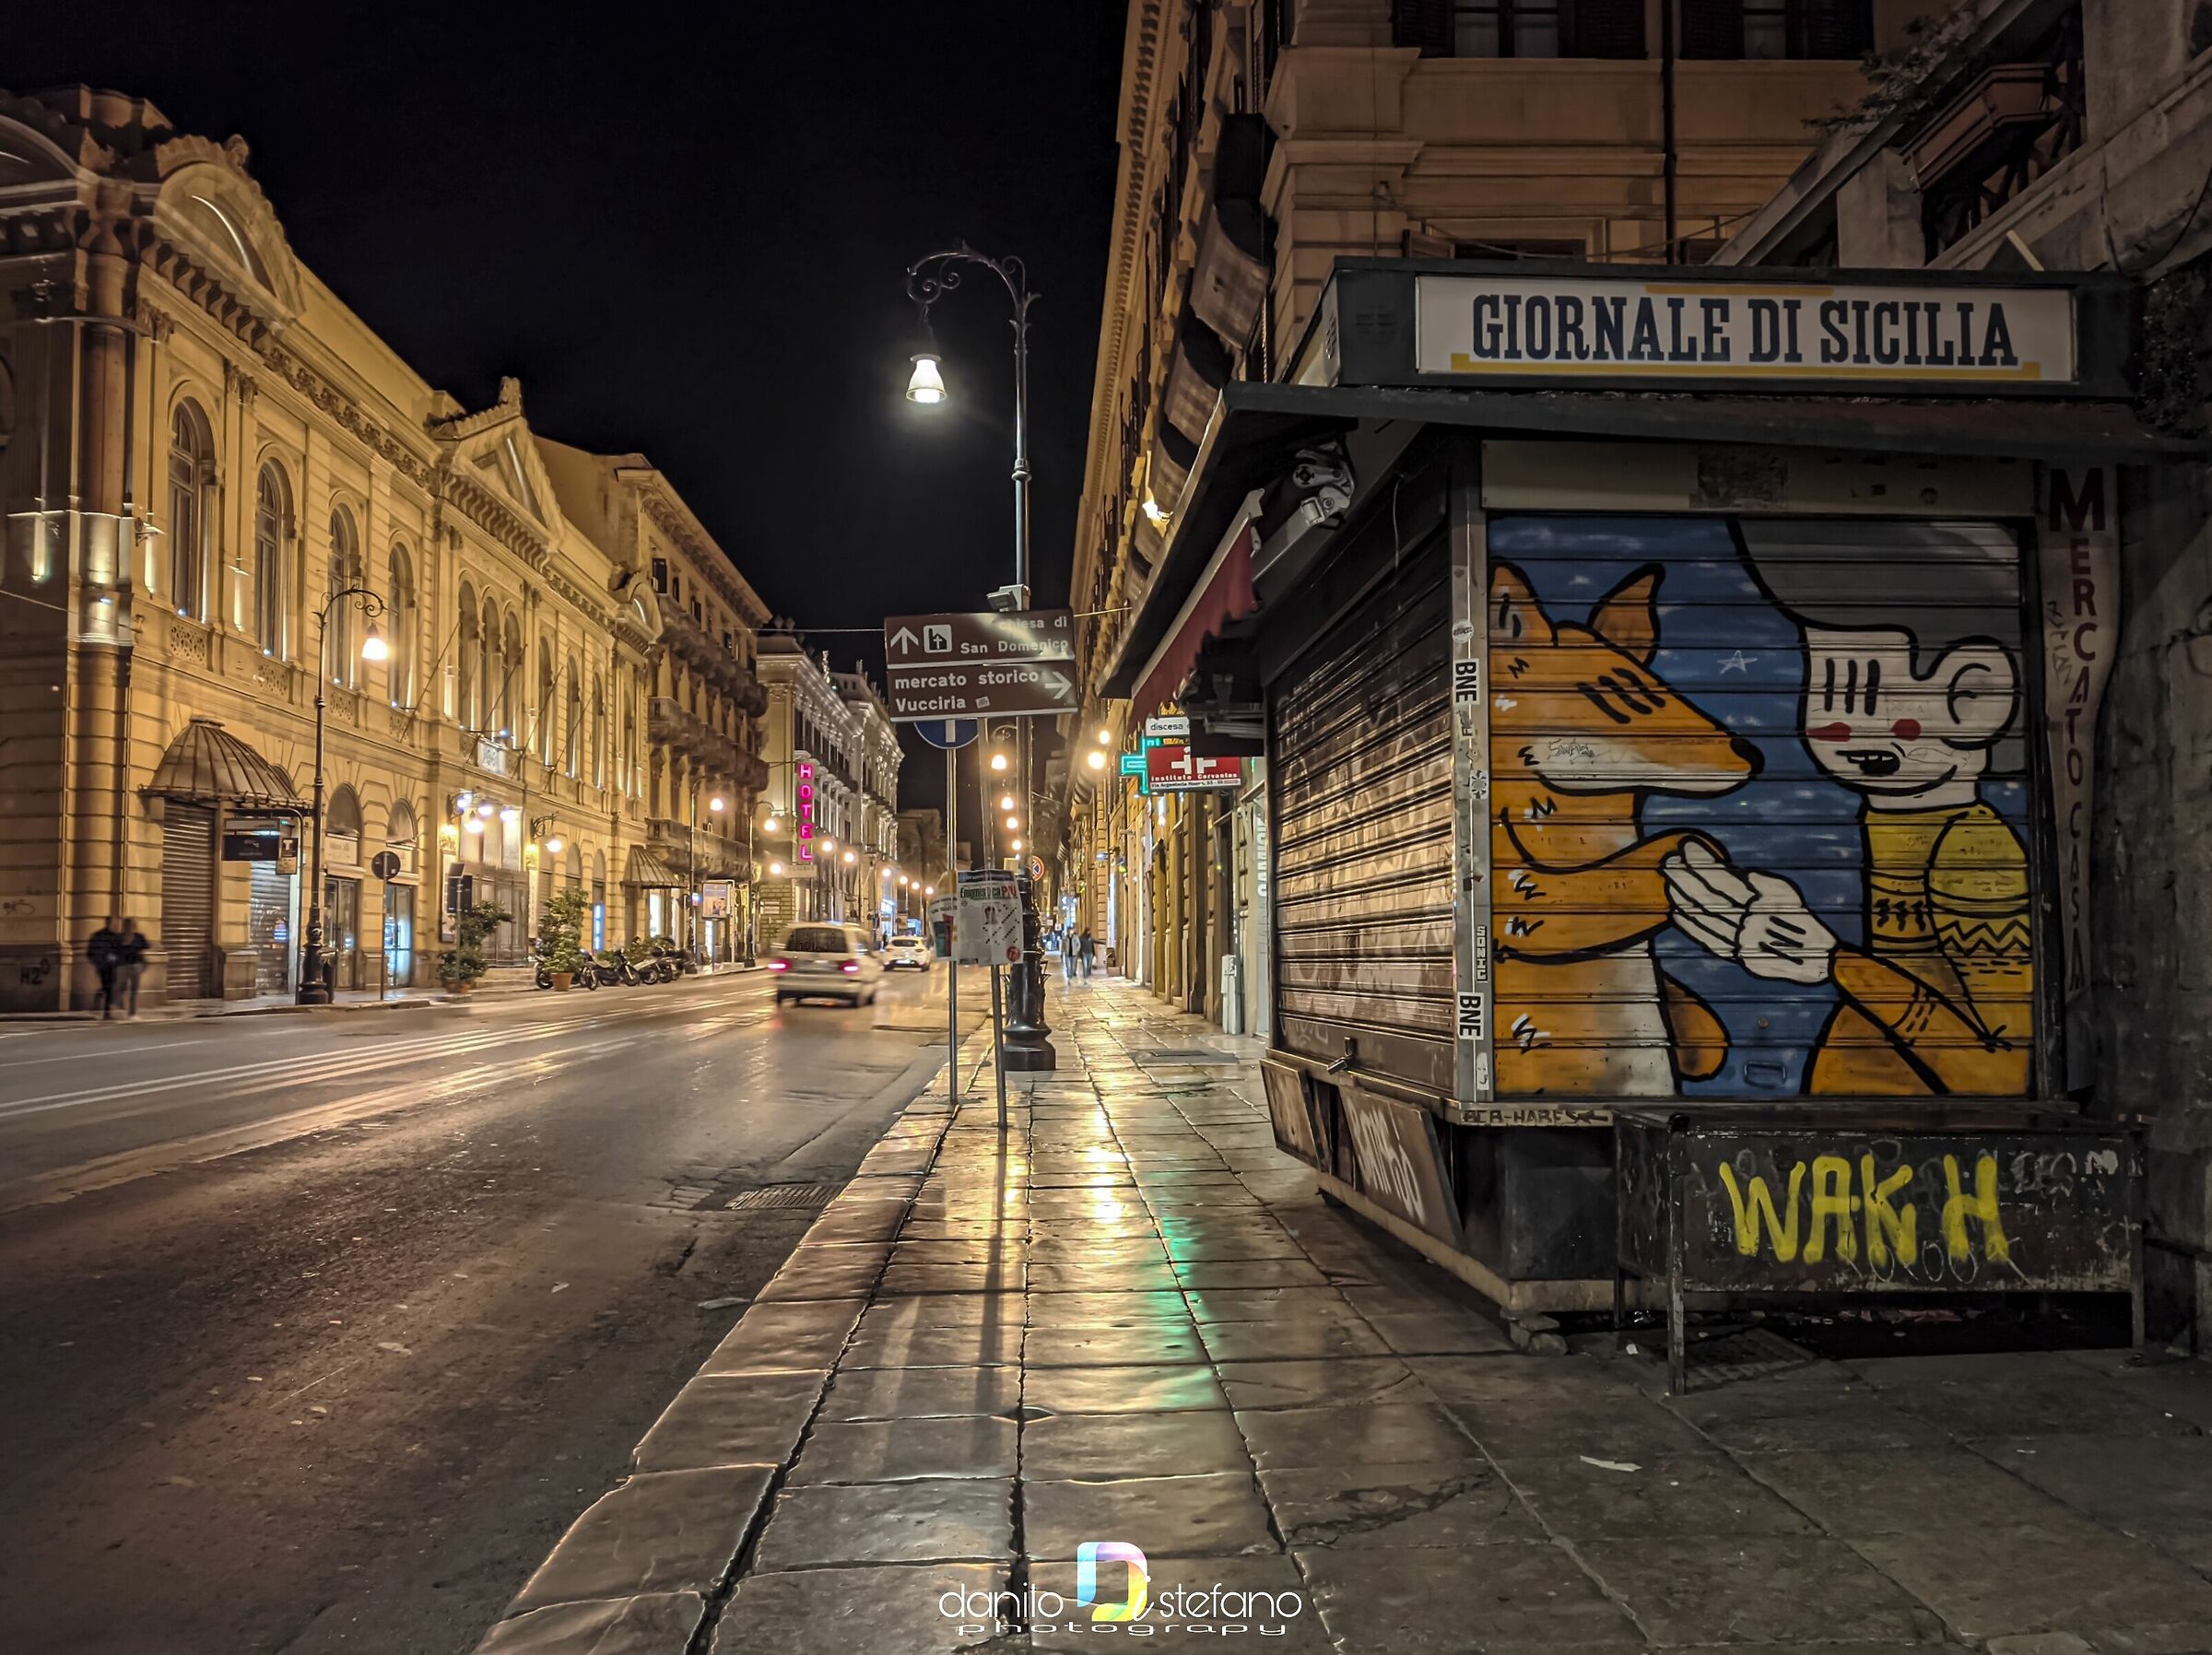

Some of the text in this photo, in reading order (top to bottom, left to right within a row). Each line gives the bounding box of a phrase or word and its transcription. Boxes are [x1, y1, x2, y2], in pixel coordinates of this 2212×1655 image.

[1473, 294, 2018, 367] GIORNALE DI SICILIA
[999, 616, 1067, 630] chiesa di
[2048, 467, 2105, 787] MERCATO
[960, 638, 1068, 654] San Domenico
[895, 669, 1039, 689] mercato storico
[1456, 661, 1477, 704] BNE
[895, 695, 967, 712] Vucciria
[1150, 722, 1183, 731] discesa
[799, 764, 813, 860] HOTEL
[2068, 802, 2085, 992] CASA
[1459, 994, 1481, 1039] BNE
